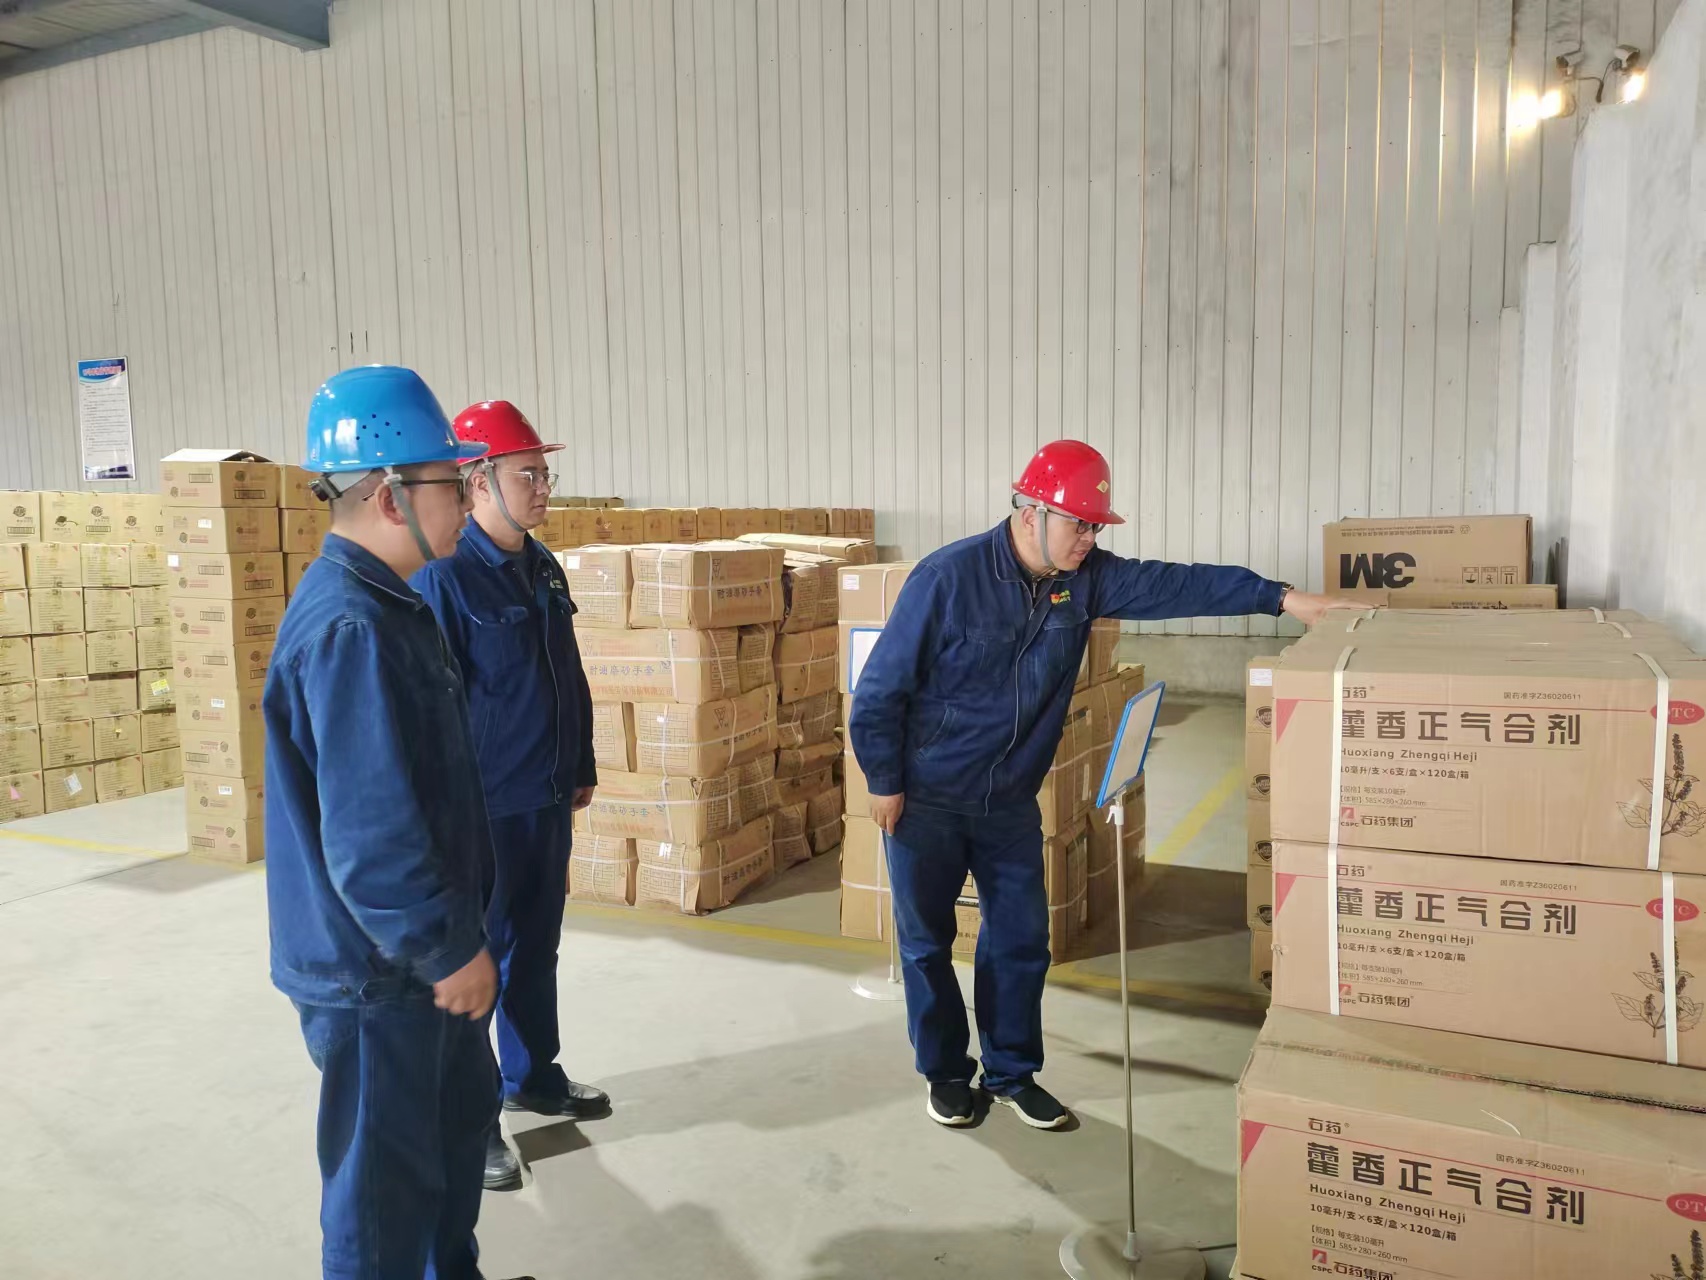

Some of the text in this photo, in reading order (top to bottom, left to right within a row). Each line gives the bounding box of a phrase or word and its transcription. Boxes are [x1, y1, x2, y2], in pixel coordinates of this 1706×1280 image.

[1340, 552, 1416, 589] 3M
[1341, 710, 1581, 745] 藿香正气合剂
[1401, 750, 1450, 761] Zhengqi
[1453, 752, 1478, 762] Heji
[1360, 815, 1413, 828] 石药集团
[1337, 865, 1365, 877] 石药
[1337, 886, 1578, 936] 藿香正气合剂
[1653, 903, 1690, 916] OC
[1338, 924, 1474, 947] Huoxiang Zhengqi Heji
[1358, 992, 1410, 1008] 石药集团
[1308, 1117, 1341, 1135] 石药
[1307, 1142, 1585, 1226] 藿香正气合剂
[1310, 1184, 1466, 1224] Huoxiang Zhengqi Heji
[1675, 1199, 1706, 1214] OT
[1310, 1204, 1457, 1241] 10毫升/支×6支/盒×120盒/箱
[1311, 1264, 1333, 1274] CSPC
[1333, 1261, 1393, 1280] 石药集团
